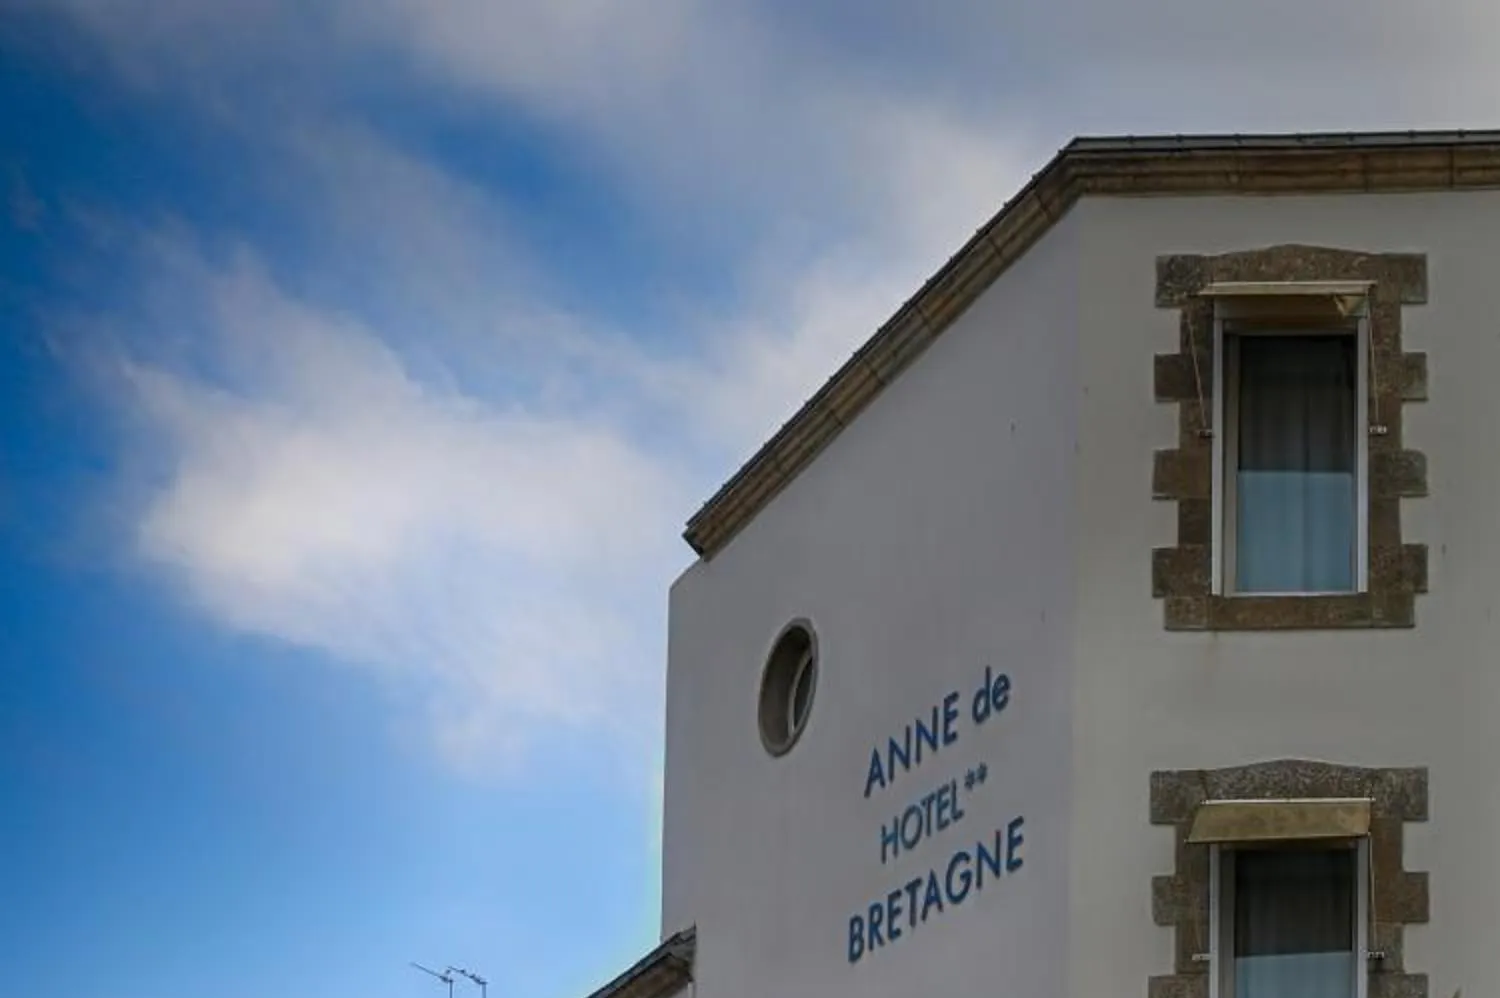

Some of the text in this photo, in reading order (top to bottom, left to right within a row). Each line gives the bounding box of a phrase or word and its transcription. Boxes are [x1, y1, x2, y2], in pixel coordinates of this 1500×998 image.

[864, 665, 1011, 799] ANNE de
[848, 815, 1025, 963] BRETAGNE
